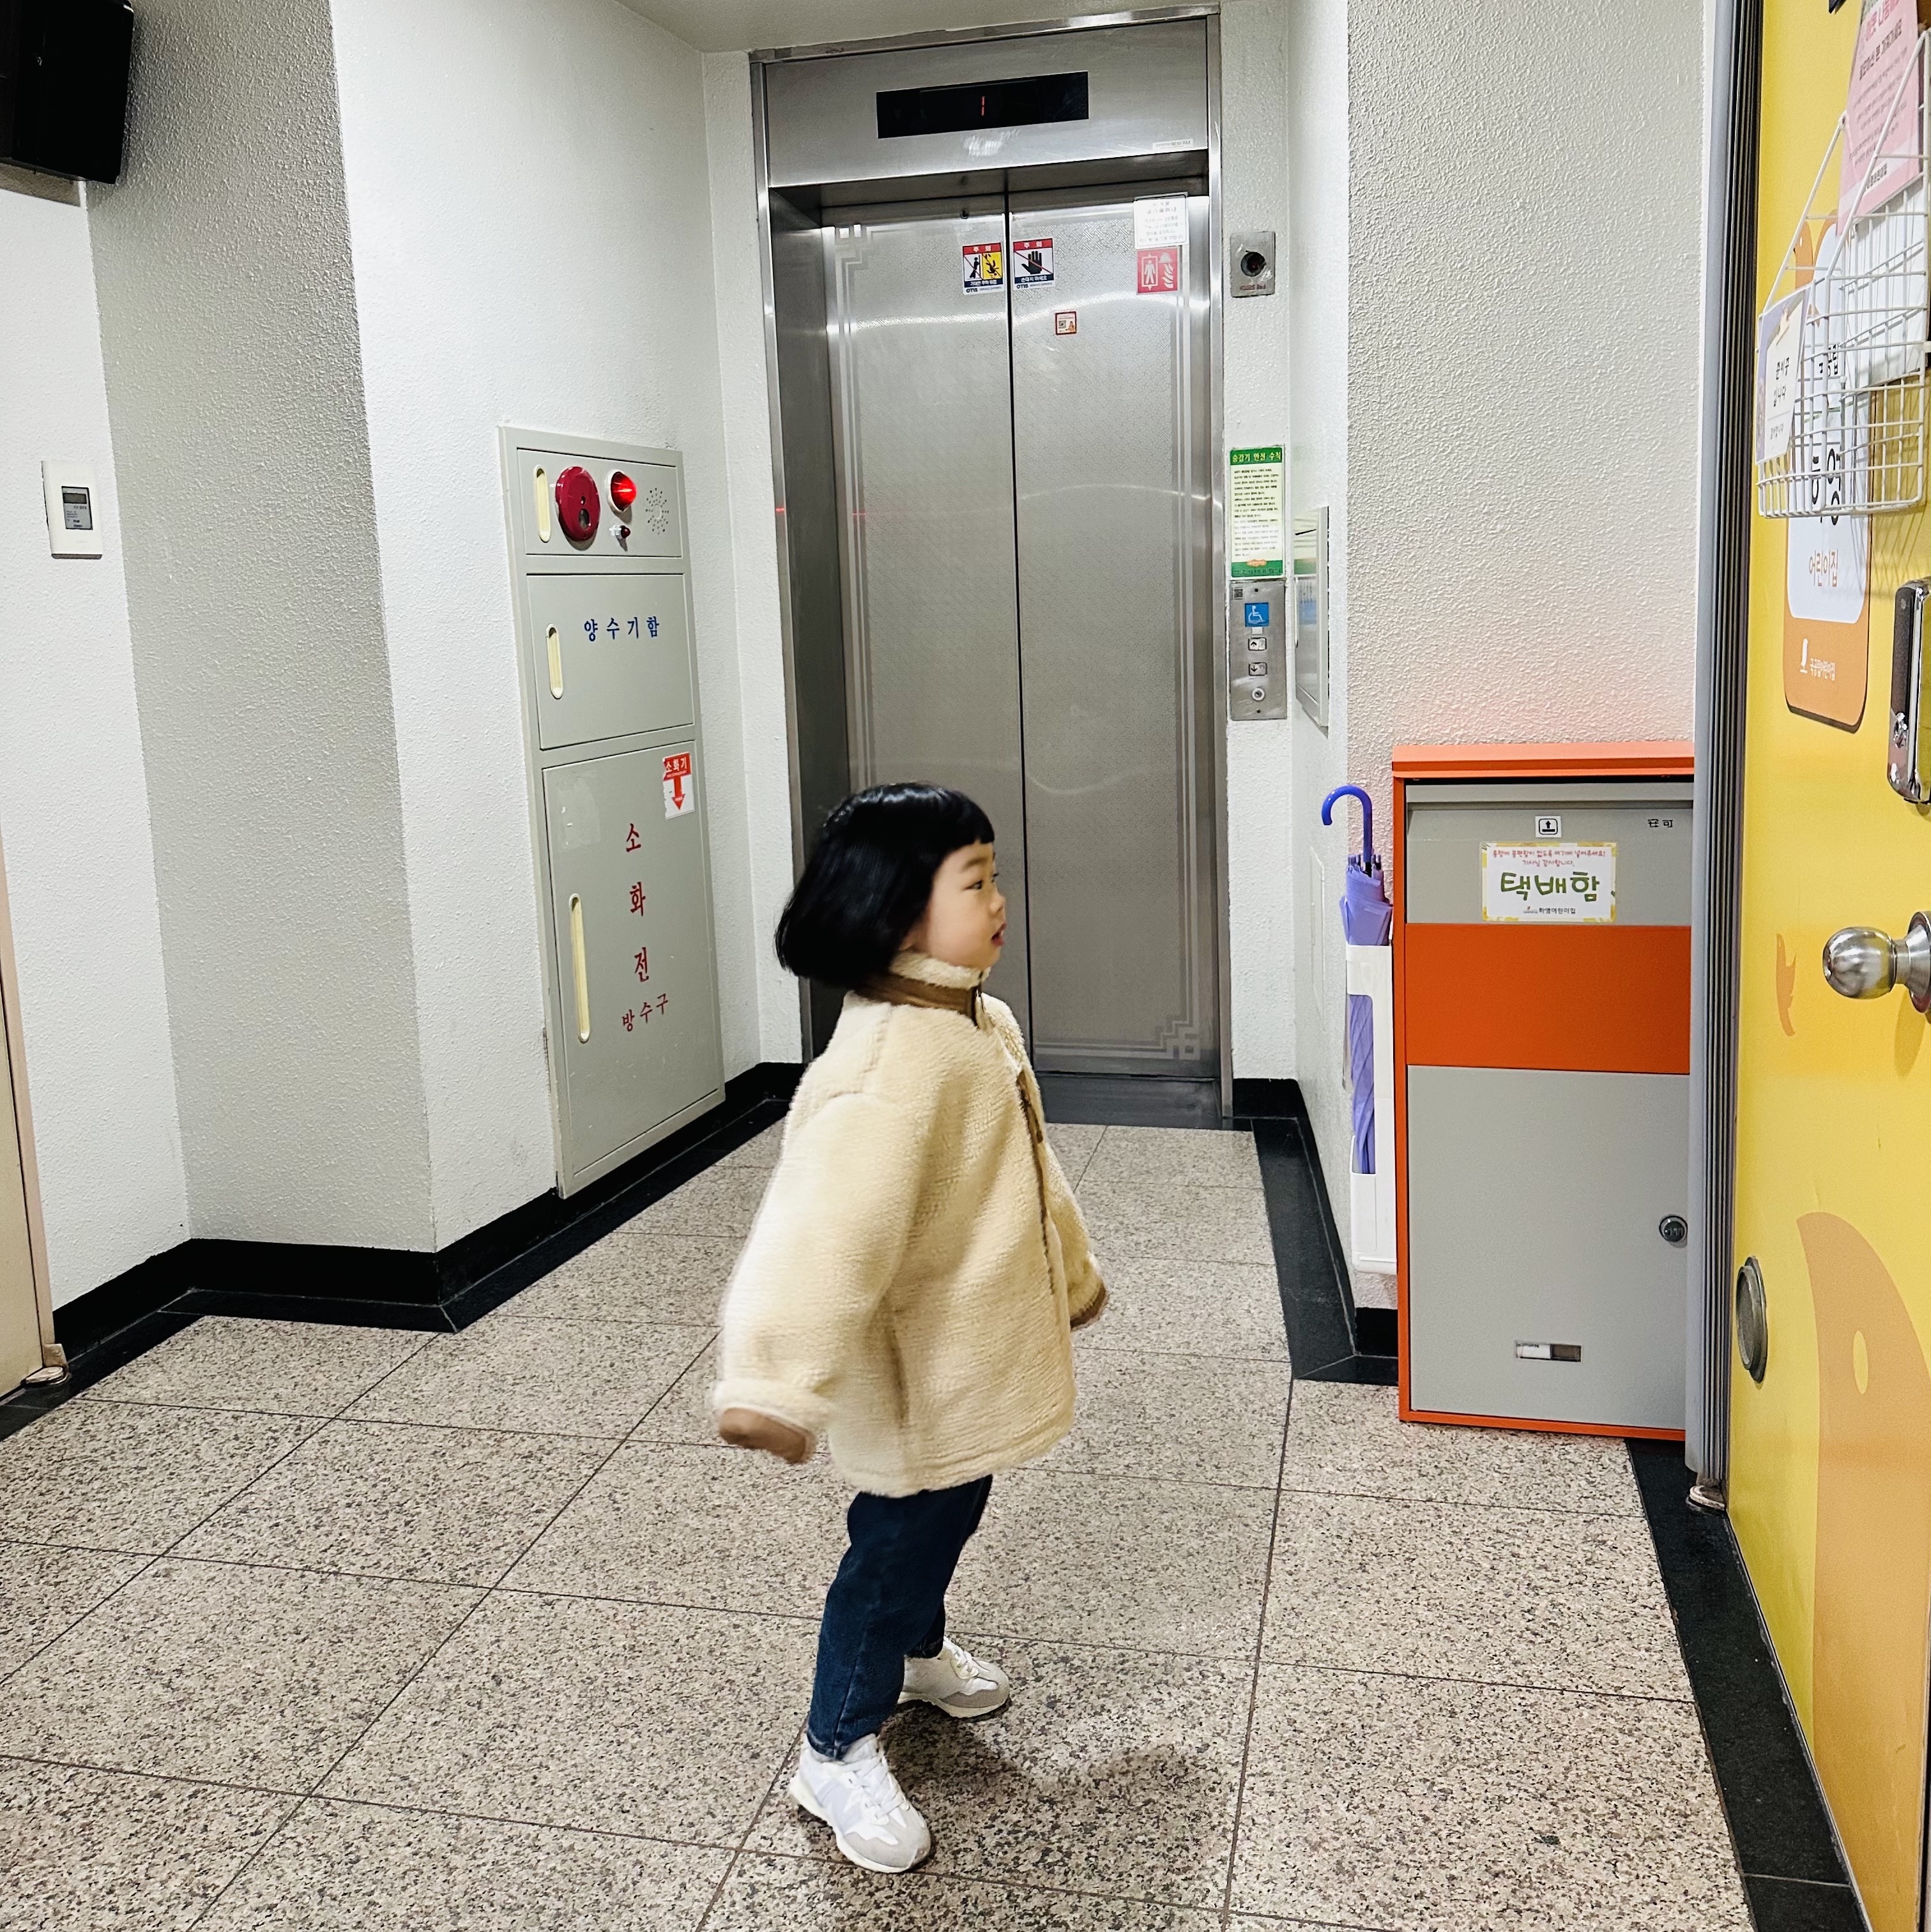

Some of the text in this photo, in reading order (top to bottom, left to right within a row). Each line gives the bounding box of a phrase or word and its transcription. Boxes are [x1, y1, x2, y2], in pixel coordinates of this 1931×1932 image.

[981, 96, 985, 116] 1
[1232, 453, 1251, 463] 승강기
[1253, 452, 1266, 462] 안전
[1809, 549, 1839, 588] 어린이집
[666, 757, 687, 773] 소화기
[1501, 871, 1600, 902] 택배함
[622, 993, 669, 1032] 방수구
